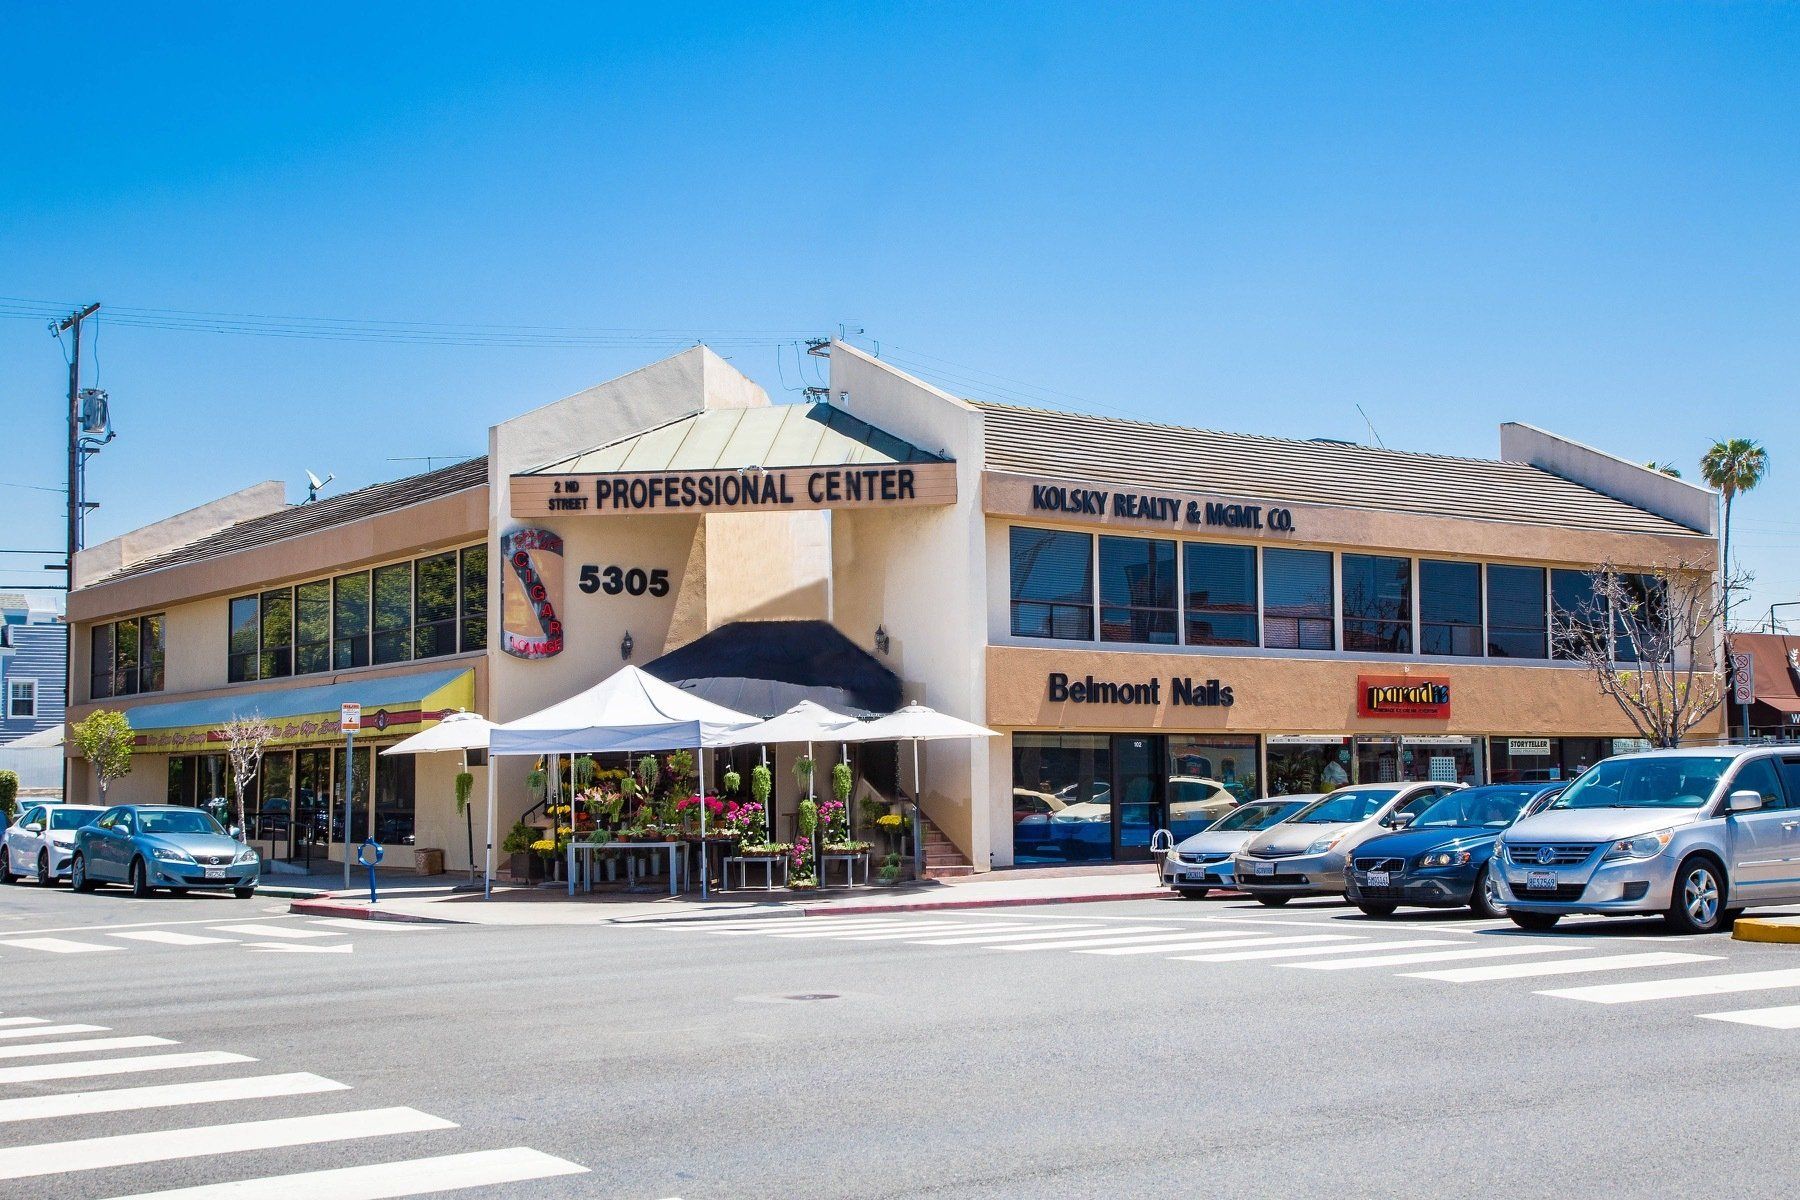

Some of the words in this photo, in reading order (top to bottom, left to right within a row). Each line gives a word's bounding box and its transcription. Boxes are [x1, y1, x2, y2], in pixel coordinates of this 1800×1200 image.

[548, 497, 589, 511] STREET
[554, 481, 561, 494] 2
[565, 481, 580, 494] ND
[596, 473, 794, 510] PROFESSIONAL
[807, 469, 916, 503] CENTER
[1033, 484, 1109, 515] KOLSKY
[1113, 493, 1182, 523] REALTY
[1186, 500, 1202, 525] &
[1205, 502, 1264, 530] MGMT.
[1267, 507, 1296, 532] CO.
[513, 551, 563, 636] CIGAR
[578, 564, 671, 599] 5305
[1049, 672, 1161, 705] Belmont
[1172, 677, 1235, 707] Nails
[1510, 740, 1548, 748] STORYTELLER
